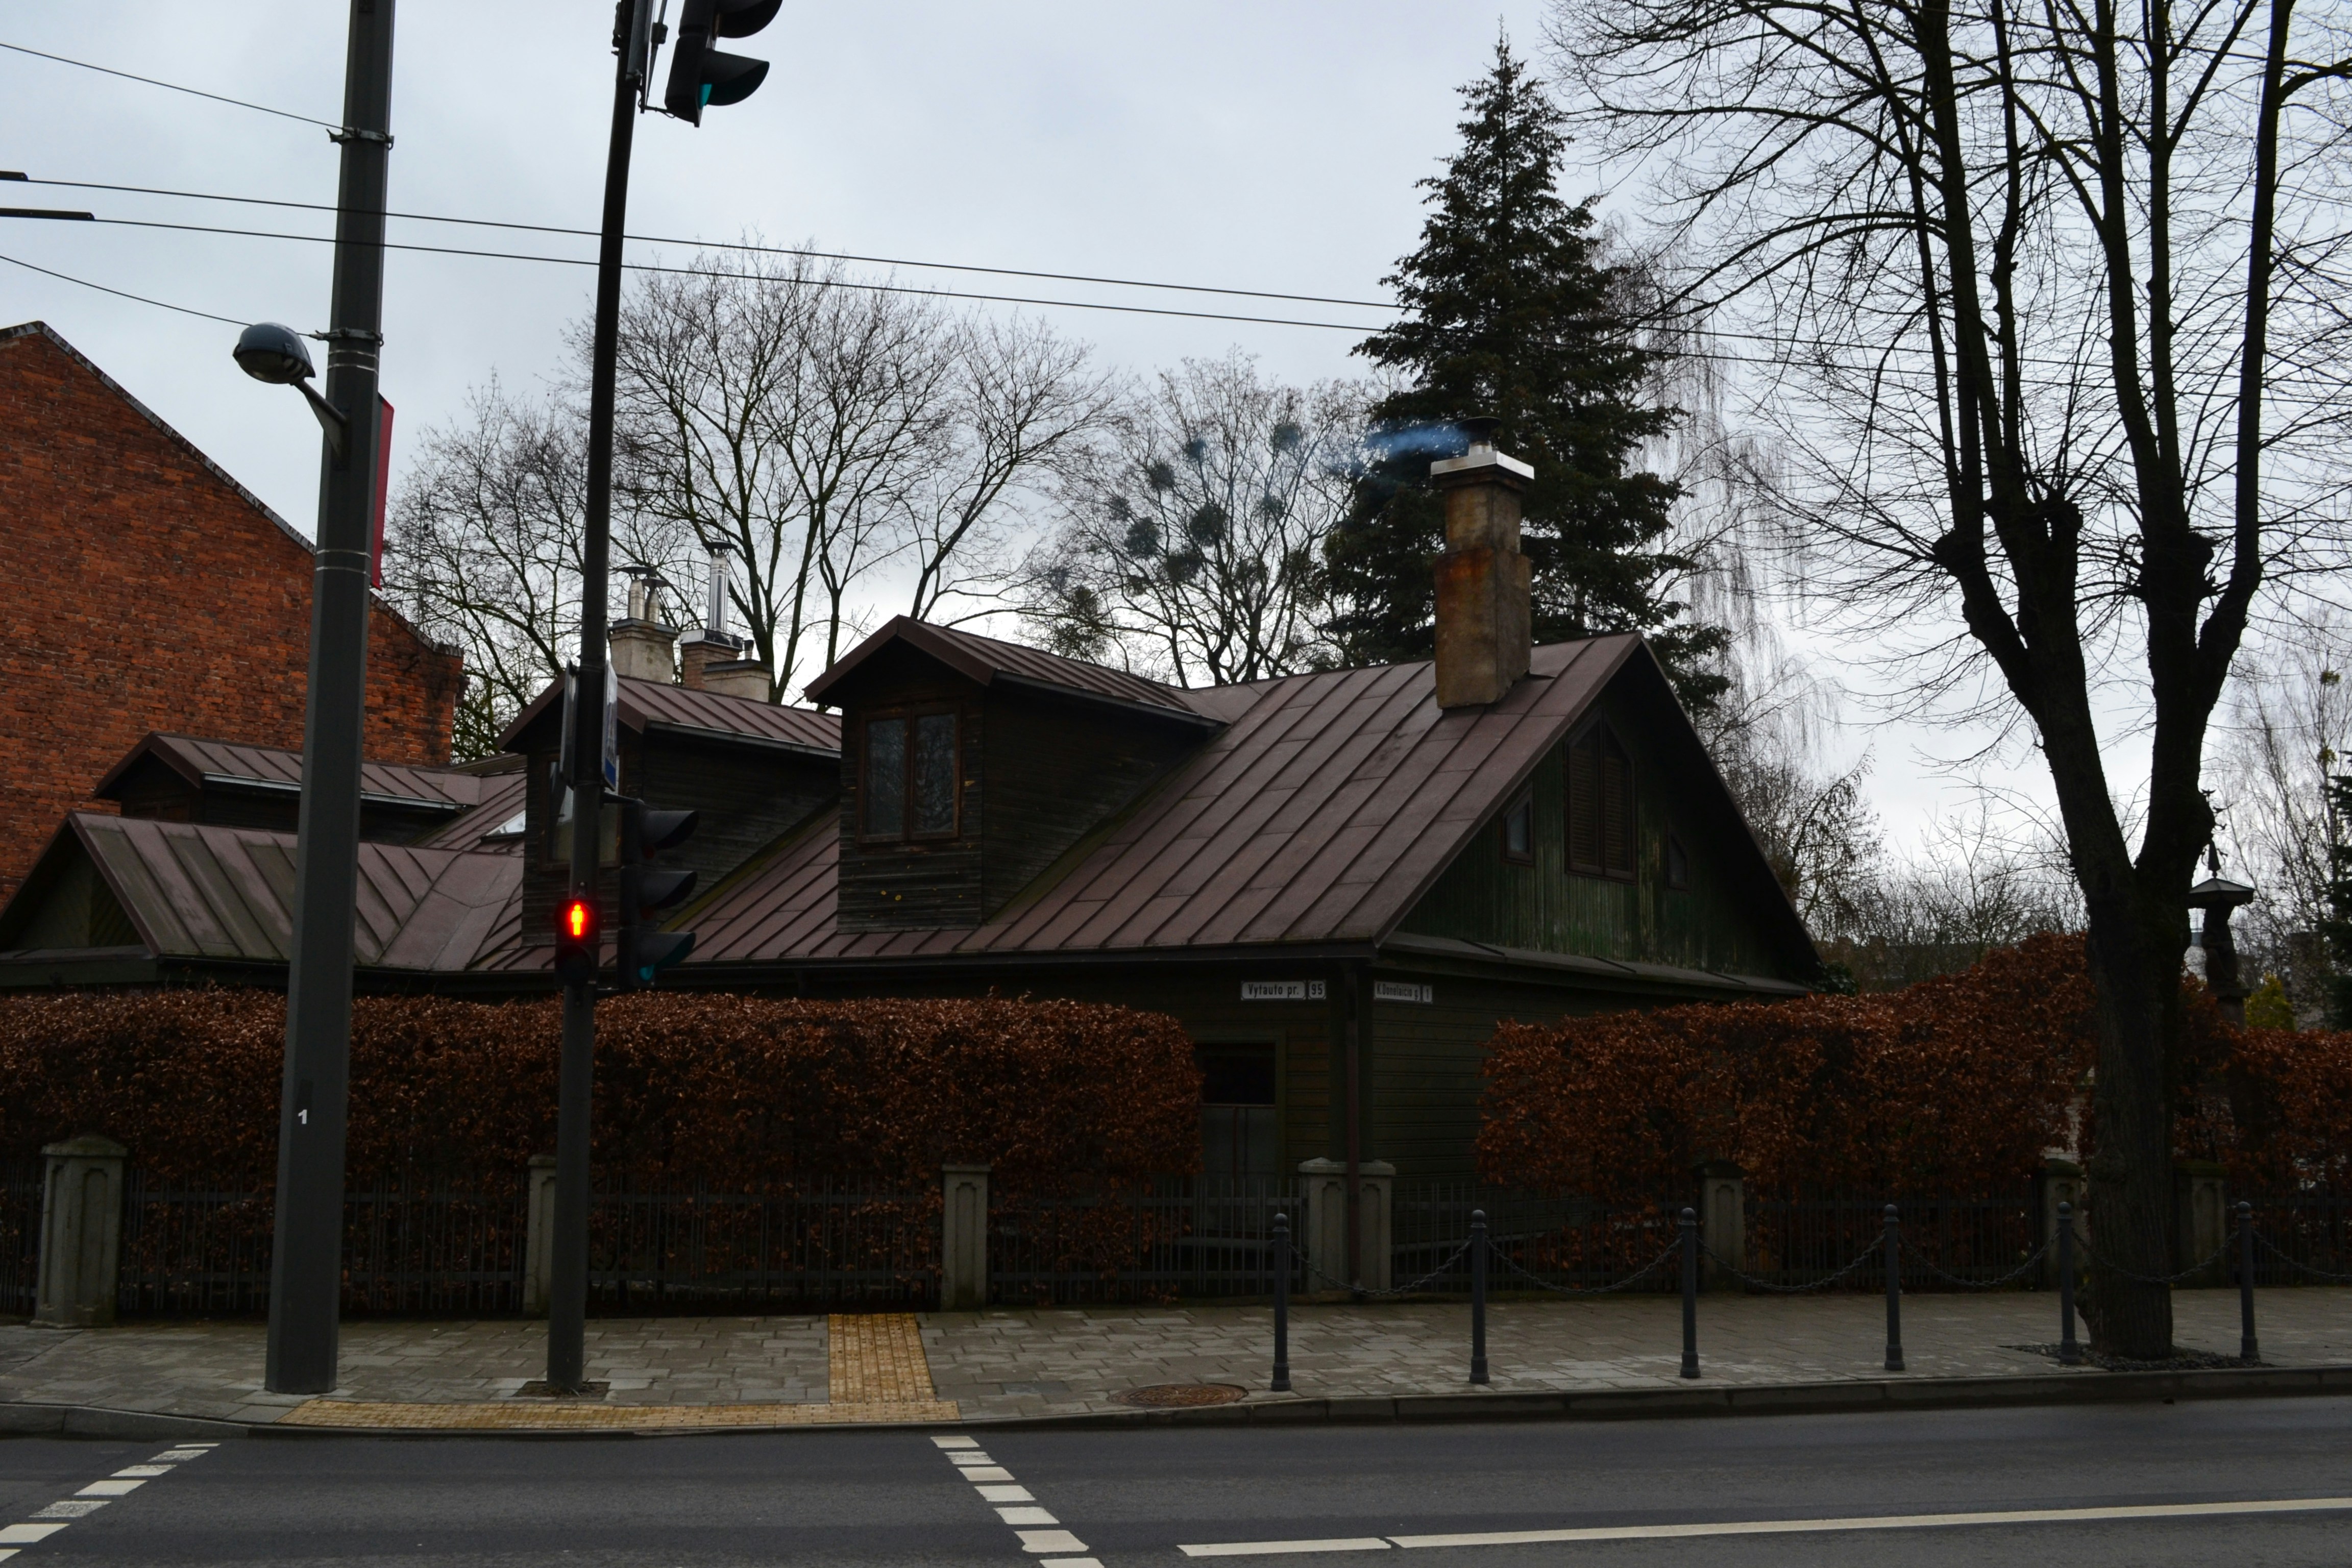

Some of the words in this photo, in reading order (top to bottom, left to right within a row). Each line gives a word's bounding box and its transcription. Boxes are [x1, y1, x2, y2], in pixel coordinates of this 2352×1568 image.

[1248, 984, 1283, 998] Vytauto
[1288, 986, 1299, 998] pr.
[1311, 984, 1322, 995] 95
[298, 1109, 308, 1124] 1
